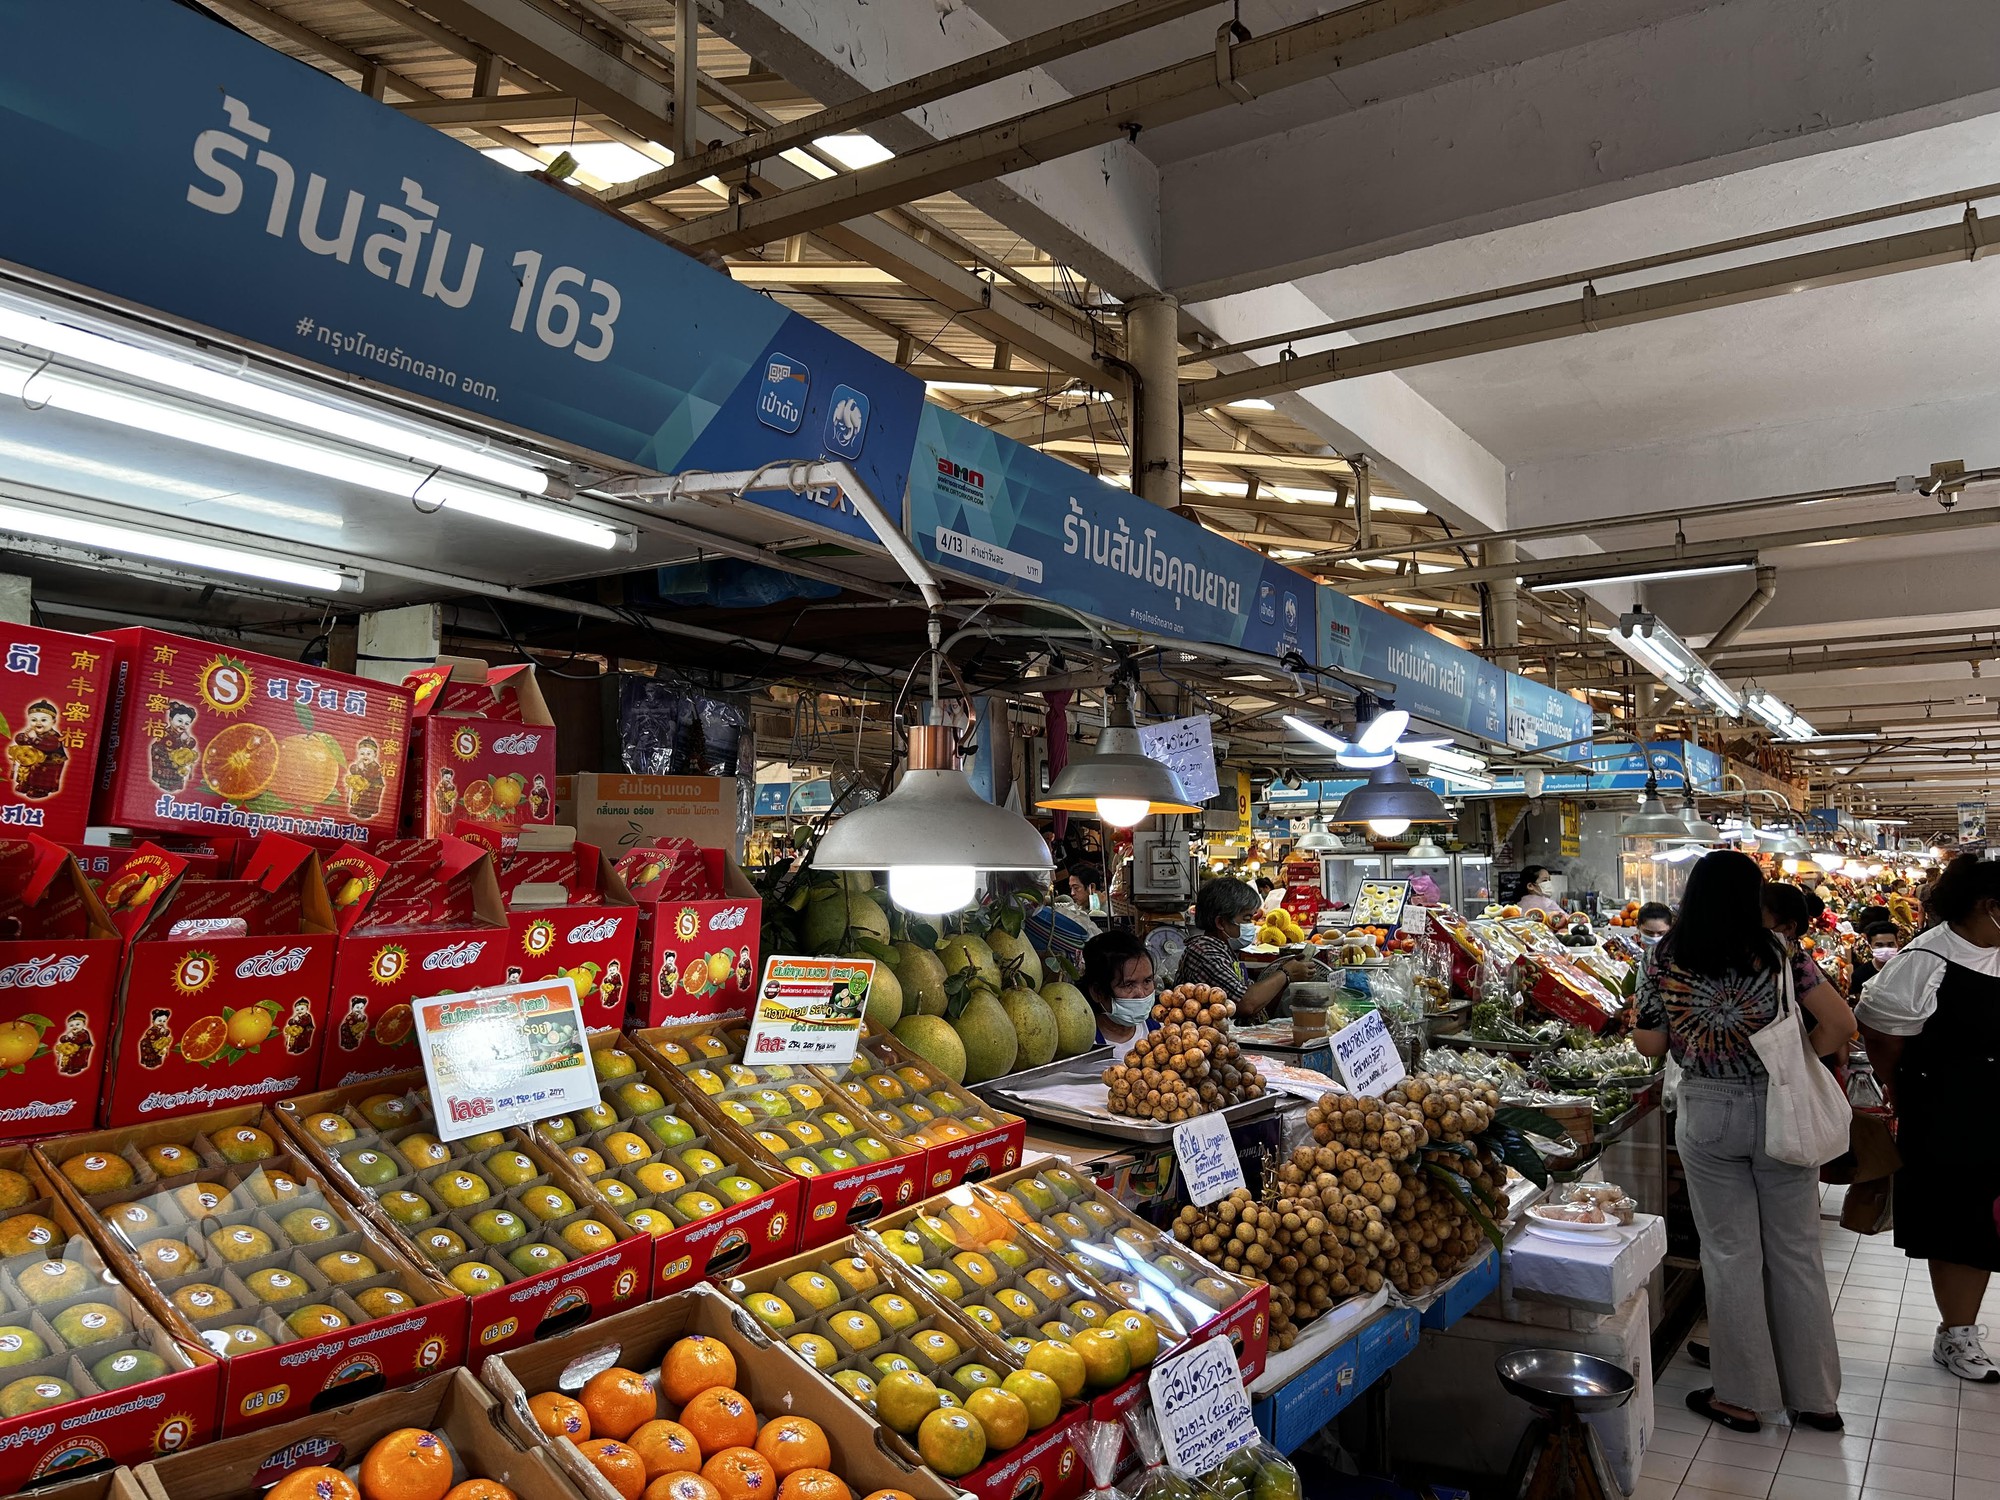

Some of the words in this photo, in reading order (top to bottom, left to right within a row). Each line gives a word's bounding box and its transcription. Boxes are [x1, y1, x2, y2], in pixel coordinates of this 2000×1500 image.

[186, 96, 484, 309] ร้านส้ม
[508, 249, 621, 363] 163
[462, 377, 500, 403] อตก.
[761, 391, 799, 423] เป๋าตัง
[937, 482, 984, 506] WWW.ORTORKOR.COM
[940, 533, 963, 553] 4/13
[1026, 565, 1039, 577] บาท
[1063, 496, 1240, 615] ร้านส้มโอคุณยาย
[1387, 644, 1437, 689] แหม่มผัก
[1439, 660, 1466, 699] ผลไม้
[212, 668, 239, 703] S
[1508, 714, 1526, 741] 4/15
[460, 733, 473, 755] S
[618, 778, 702, 800] ส้มโชกุนเบตง
[633, 804, 655, 815] อร่อย
[1239, 795, 1247, 815] 9
[155, 794, 369, 843] ส้มสดคัดคุณภาพพิเศษ
[1368, 833, 1378, 844] &
[567, 917, 623, 944] สวัสดี
[681, 913, 694, 933] S
[708, 906, 750, 931] สวัสดี
[530, 928, 546, 950] S
[235, 946, 313, 980] สวัสดี
[379, 953, 397, 976] S
[421, 939, 488, 971] สวัสดี
[184, 959, 205, 987] S
[763, 1006, 788, 1020] หวาน
[788, 1005, 809, 1019] หอม
[138, 1076, 301, 1114] ส้มสดคัดคุณภาพพิเศษ
[446, 1094, 496, 1123] โลละ
[899, 1181, 911, 1202] S
[772, 1216, 784, 1237] S
[677, 1260, 690, 1273] 30
[619, 1272, 632, 1294] S
[347, 1315, 428, 1350] คัดคุณภาพทุกผล
[485, 1326, 499, 1342] ลูก
[499, 1321, 516, 1335] 30
[422, 1342, 438, 1368] S
[1161, 1349, 1232, 1410] ส้มโชกุน
[245, 1393, 262, 1412] ลูก
[263, 1388, 286, 1406] 30
[61, 1391, 166, 1433] คัดคุณภาพทุกผล
[1174, 1414, 1207, 1445] เบตง
[1207, 1390, 1243, 1424] (ยะลา)
[164, 1420, 185, 1447] S
[1061, 1454, 1072, 1475] S
